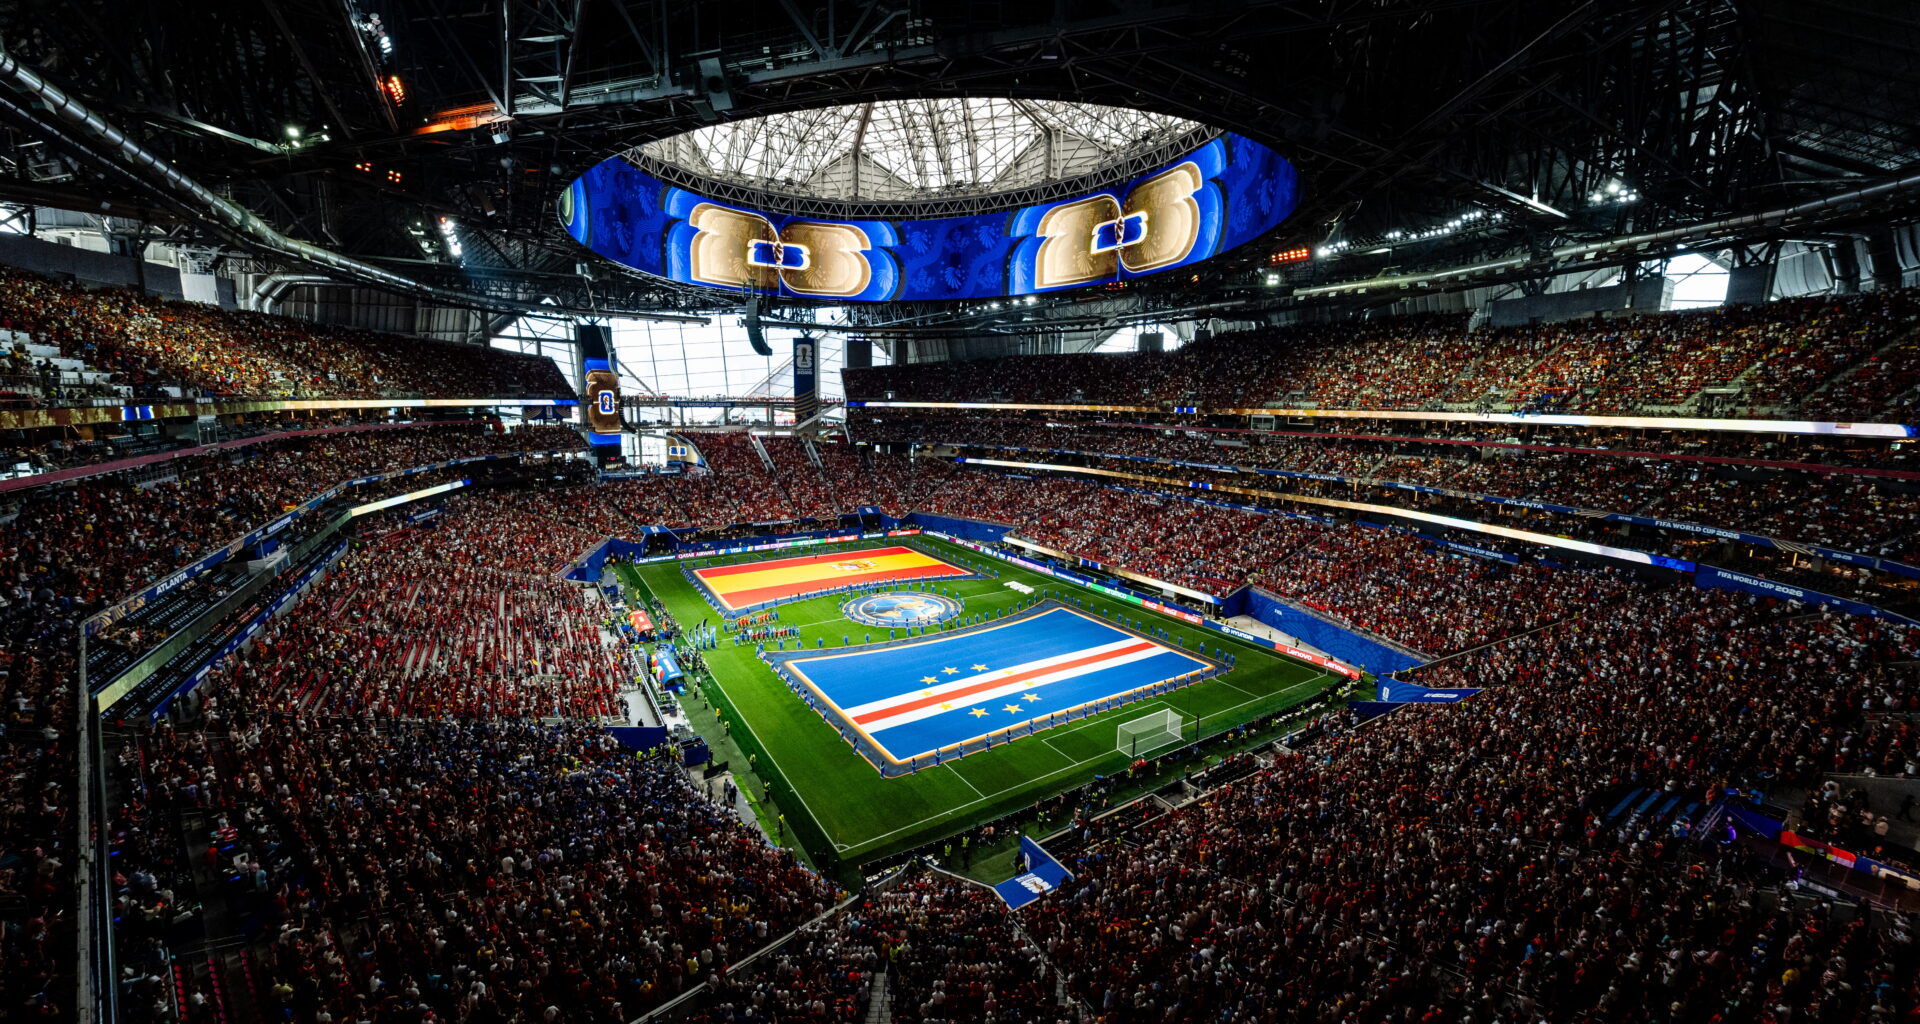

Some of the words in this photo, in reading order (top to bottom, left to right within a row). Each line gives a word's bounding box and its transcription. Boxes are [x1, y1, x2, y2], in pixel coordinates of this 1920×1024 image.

[1308, 473, 1338, 481] ATLANTA
[1504, 499, 1544, 509] ATLANTA
[1654, 520, 1672, 528] FIFA
[1672, 522, 1702, 533] WORLD
[1702, 527, 1716, 535] CUP
[1715, 530, 1741, 540] 2026
[1458, 544, 1475, 552] WORLD
[155, 571, 188, 596] ATLANTA
[1716, 570, 1732, 580] FIFA
[1732, 573, 1759, 587] WORLD
[1759, 579, 1775, 591] CUP
[1774, 585, 1804, 598] 2026
[1286, 647, 1312, 661] Lenovo
[1323, 659, 1348, 675] Lenovo
